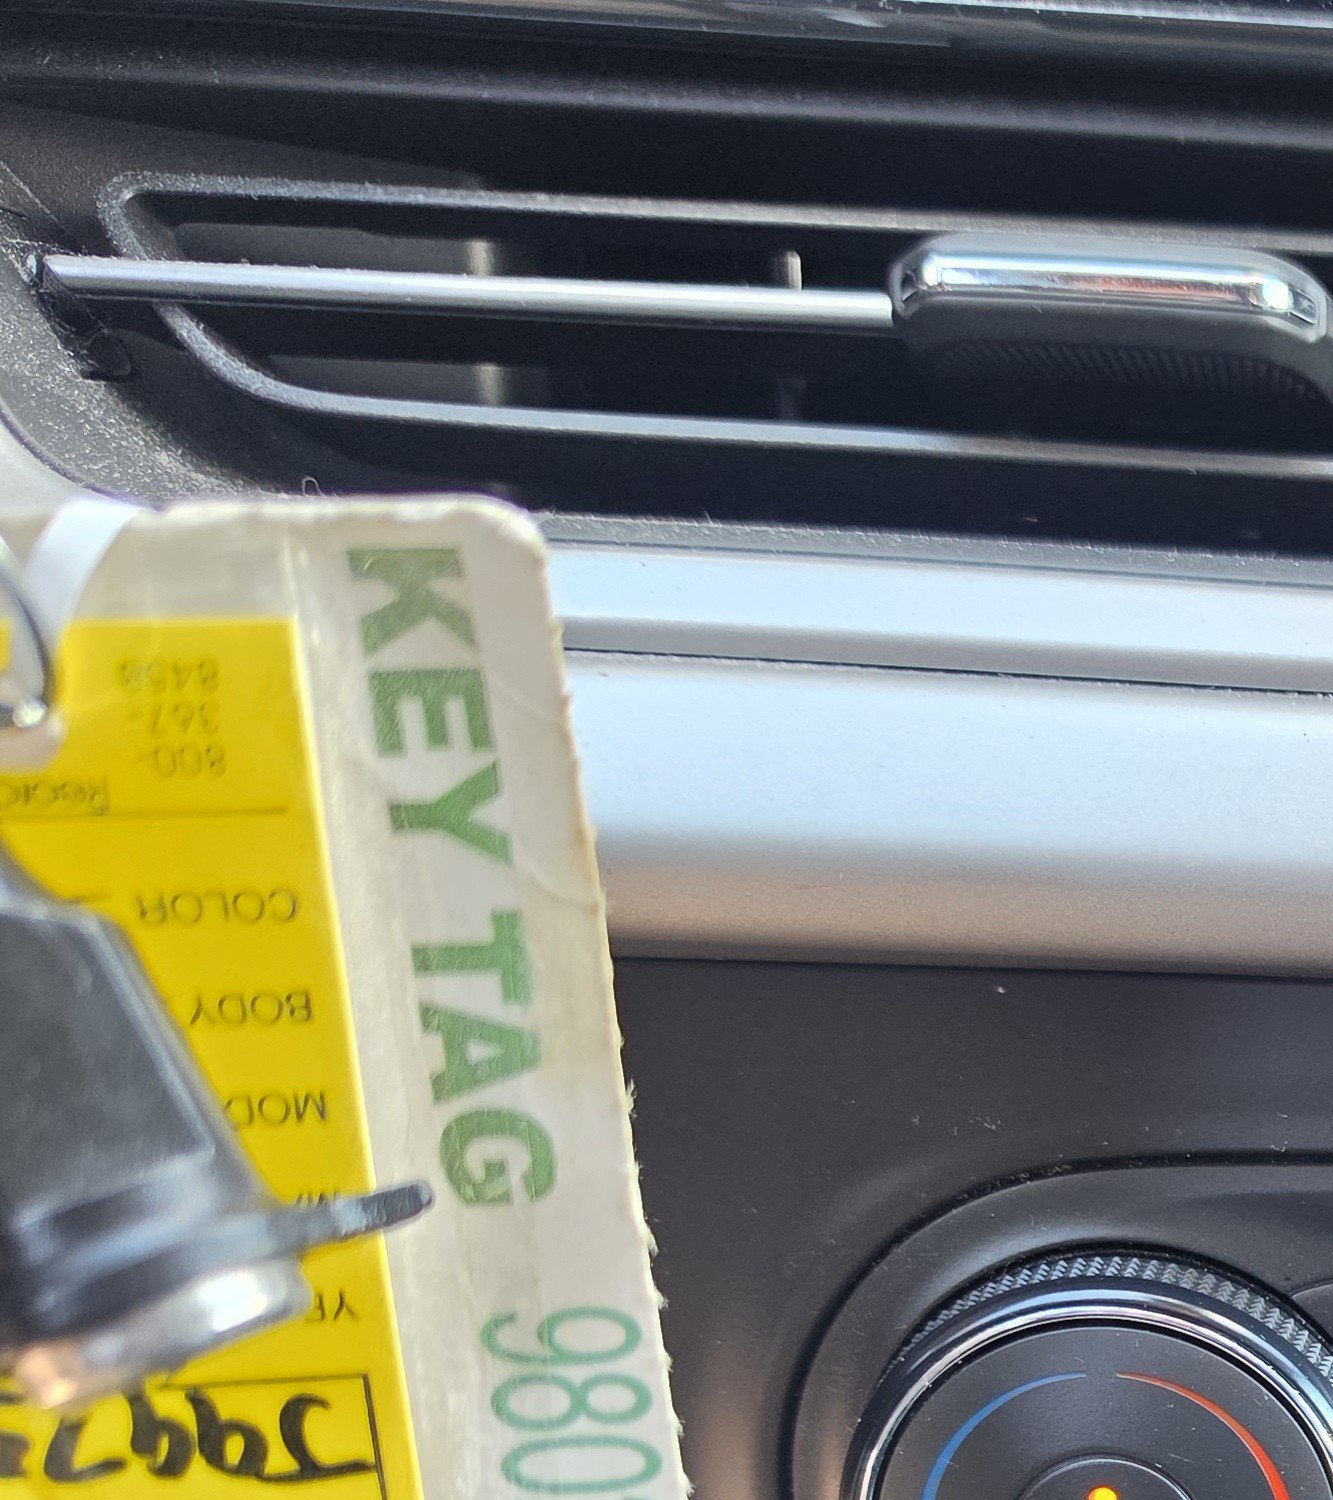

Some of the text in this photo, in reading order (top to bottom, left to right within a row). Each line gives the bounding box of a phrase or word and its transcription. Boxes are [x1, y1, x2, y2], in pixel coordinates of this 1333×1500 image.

[346, 546, 557, 1208] KEY TAG
[134, 888, 298, 926] COLOR
[188, 989, 313, 1026] BODY
[221, 1090, 328, 1129] MOD
